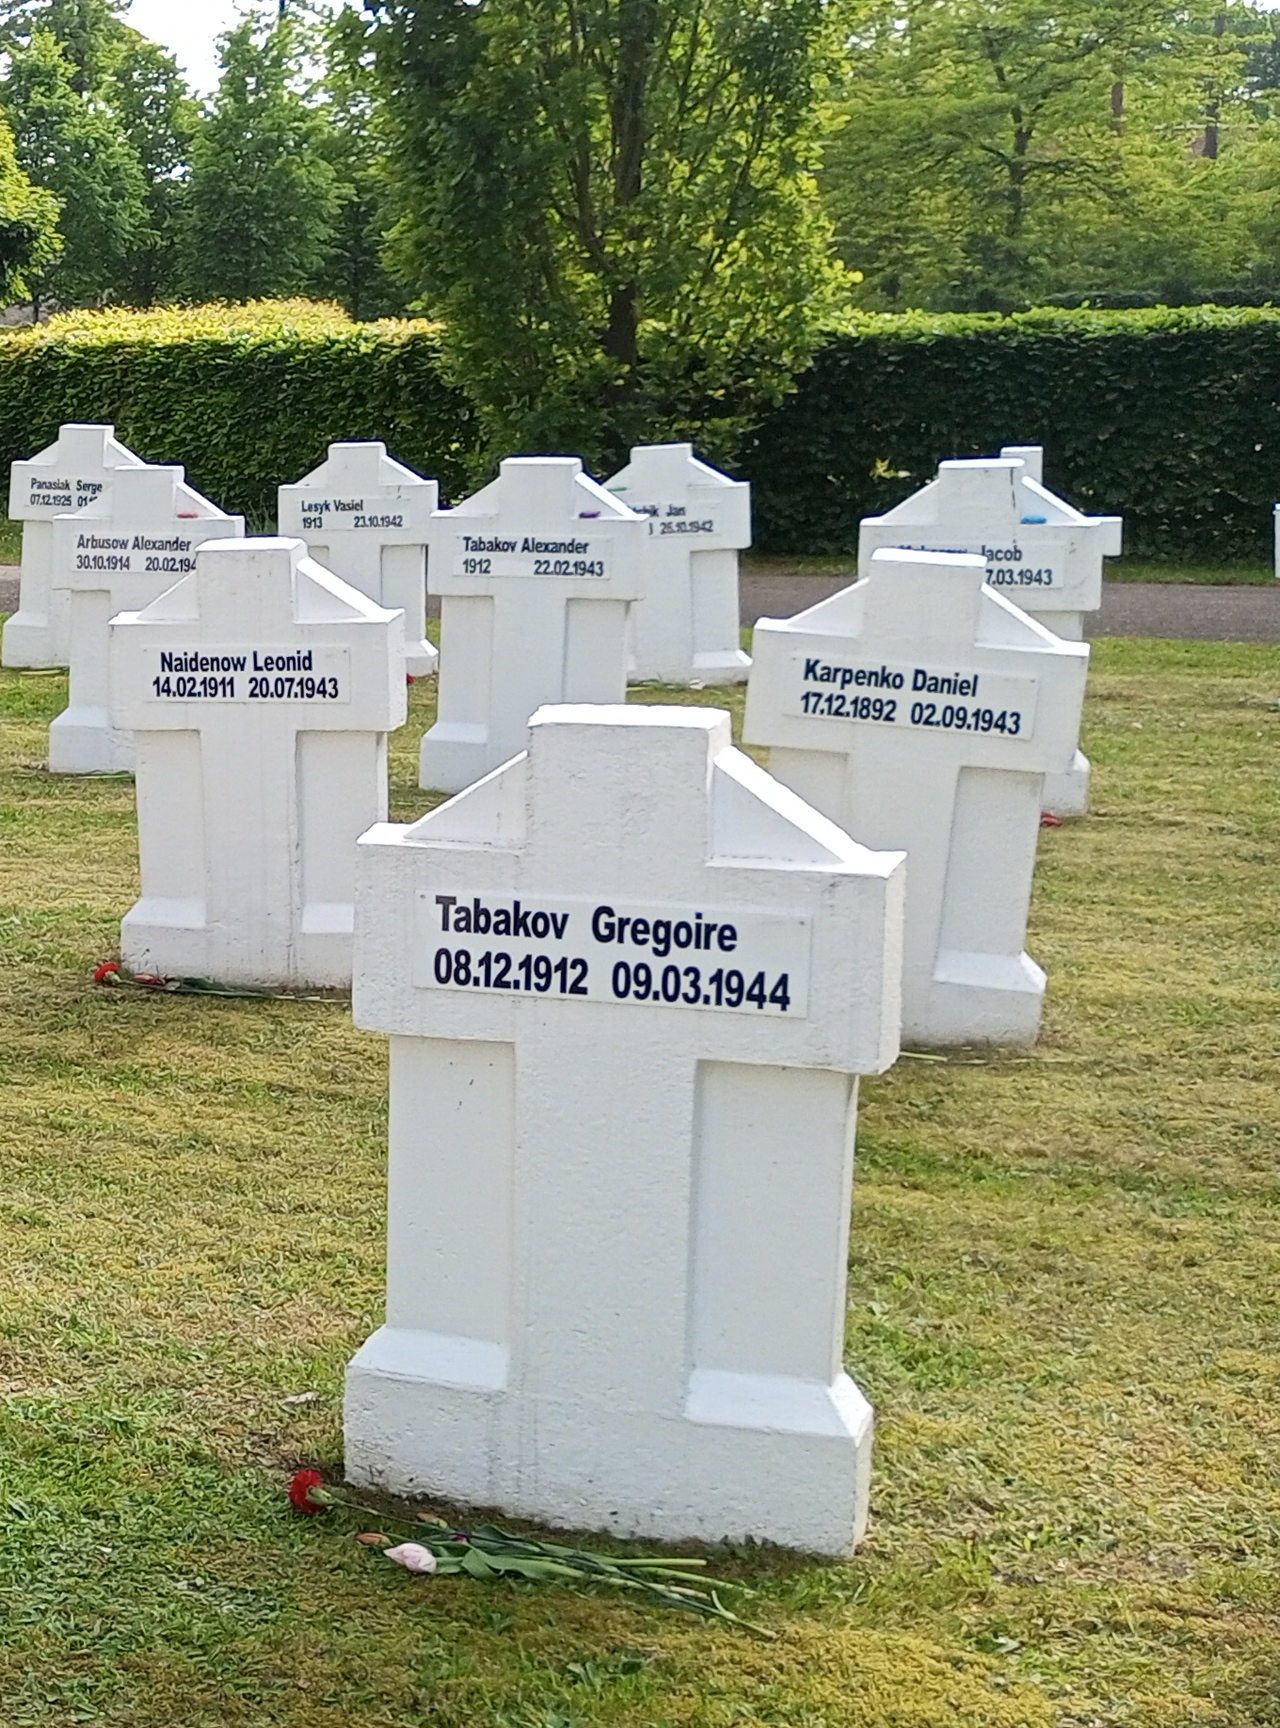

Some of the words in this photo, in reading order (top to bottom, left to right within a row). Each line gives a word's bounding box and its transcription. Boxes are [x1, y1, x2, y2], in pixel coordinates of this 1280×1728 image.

[76, 479, 103, 494] Serge
[301, 500, 331, 515] Lesyk
[302, 516, 323, 529] 1913
[353, 514, 403, 528] 23.10.1942
[76, 534, 129, 550] Arbusow
[132, 535, 192, 552] Alexander
[462, 537, 518, 552] Tabakov
[521, 537, 589, 554] Alexander
[76, 555, 130, 570] 30.10.1914
[145, 556, 197, 573] 20.02.194
[463, 558, 491, 574] 1912
[534, 560, 604, 577] 22.02.1943
[985, 568, 1052, 586] 7.03.1943
[160, 651, 247, 672] Naidenow
[252, 650, 313, 672] Leonid
[803, 658, 904, 691] Karpenko
[912, 668, 979, 698] Daniel
[152, 676, 235, 698] 14.02.1911
[248, 677, 339, 699] 20.07.1943
[800, 691, 897, 722] 17.12.1892
[910, 702, 1021, 735] 02.09.1943
[435, 894, 570, 940] Tabakov
[591, 905, 738, 957] Gregoire
[433, 947, 589, 996] 08.12.1912
[611, 960, 792, 1012] 09.03.1944
